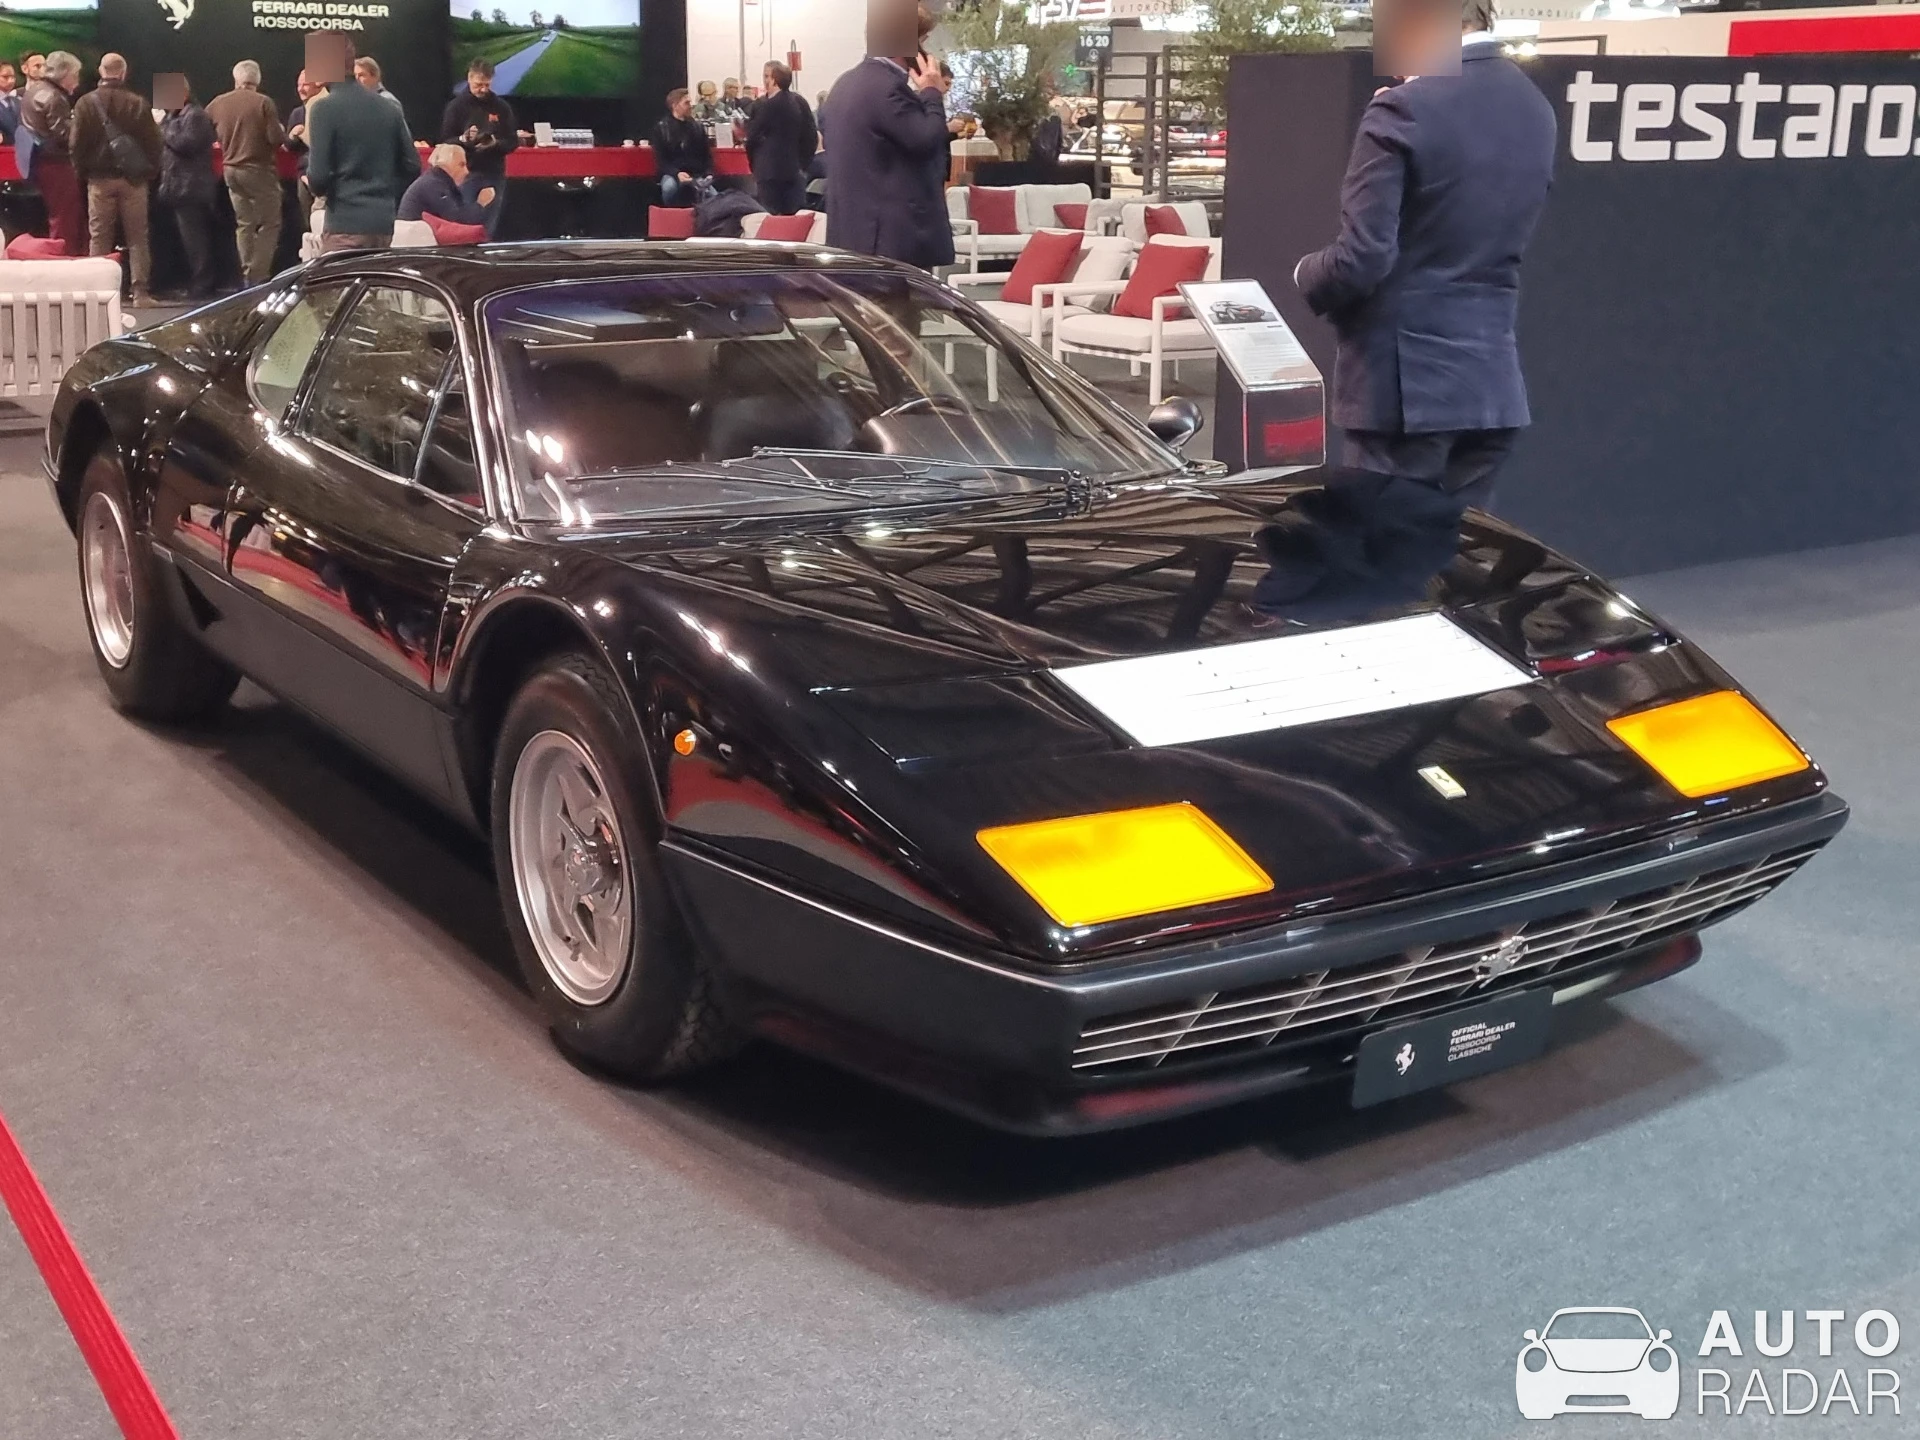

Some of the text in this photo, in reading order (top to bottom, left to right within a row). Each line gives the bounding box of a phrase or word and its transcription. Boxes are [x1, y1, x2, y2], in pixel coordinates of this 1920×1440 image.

[252, 1, 389, 17] FERRARI DEALER
[253, 16, 364, 30] ROSSOCORSA
[1566, 71, 1920, 162] testaro
[1450, 1021, 1516, 1045] FERRARI DEALER
[1451, 1022, 1487, 1037] OFFICIAL
[1449, 1034, 1501, 1053] ROSSOCORSA
[1447, 1044, 1492, 1062] CLASSICHE
